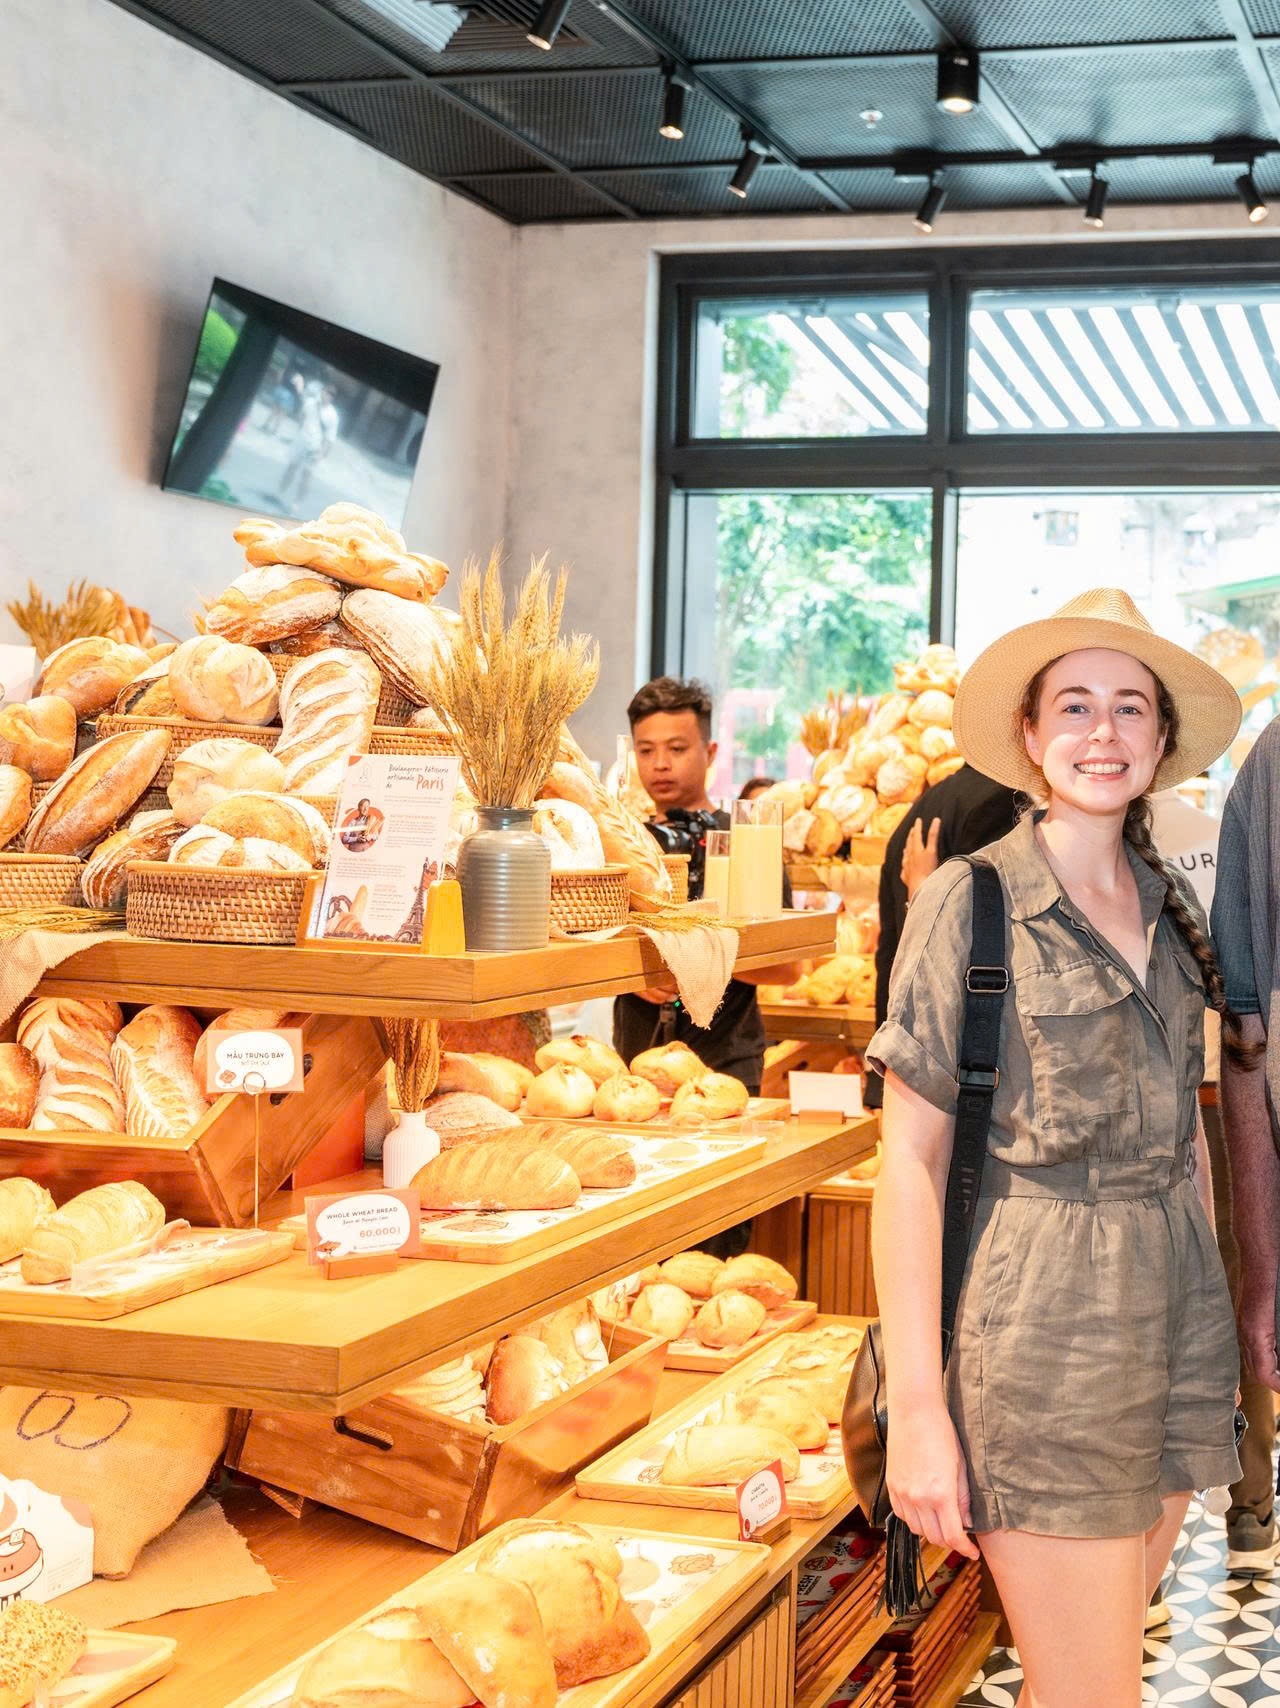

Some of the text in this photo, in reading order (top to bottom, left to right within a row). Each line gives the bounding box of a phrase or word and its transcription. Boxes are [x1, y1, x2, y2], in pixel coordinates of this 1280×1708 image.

[416, 774, 444, 791] Paris
[1178, 852, 1216, 871] UR
[326, 1206, 398, 1220] WHOLE WHEAT BREAD
